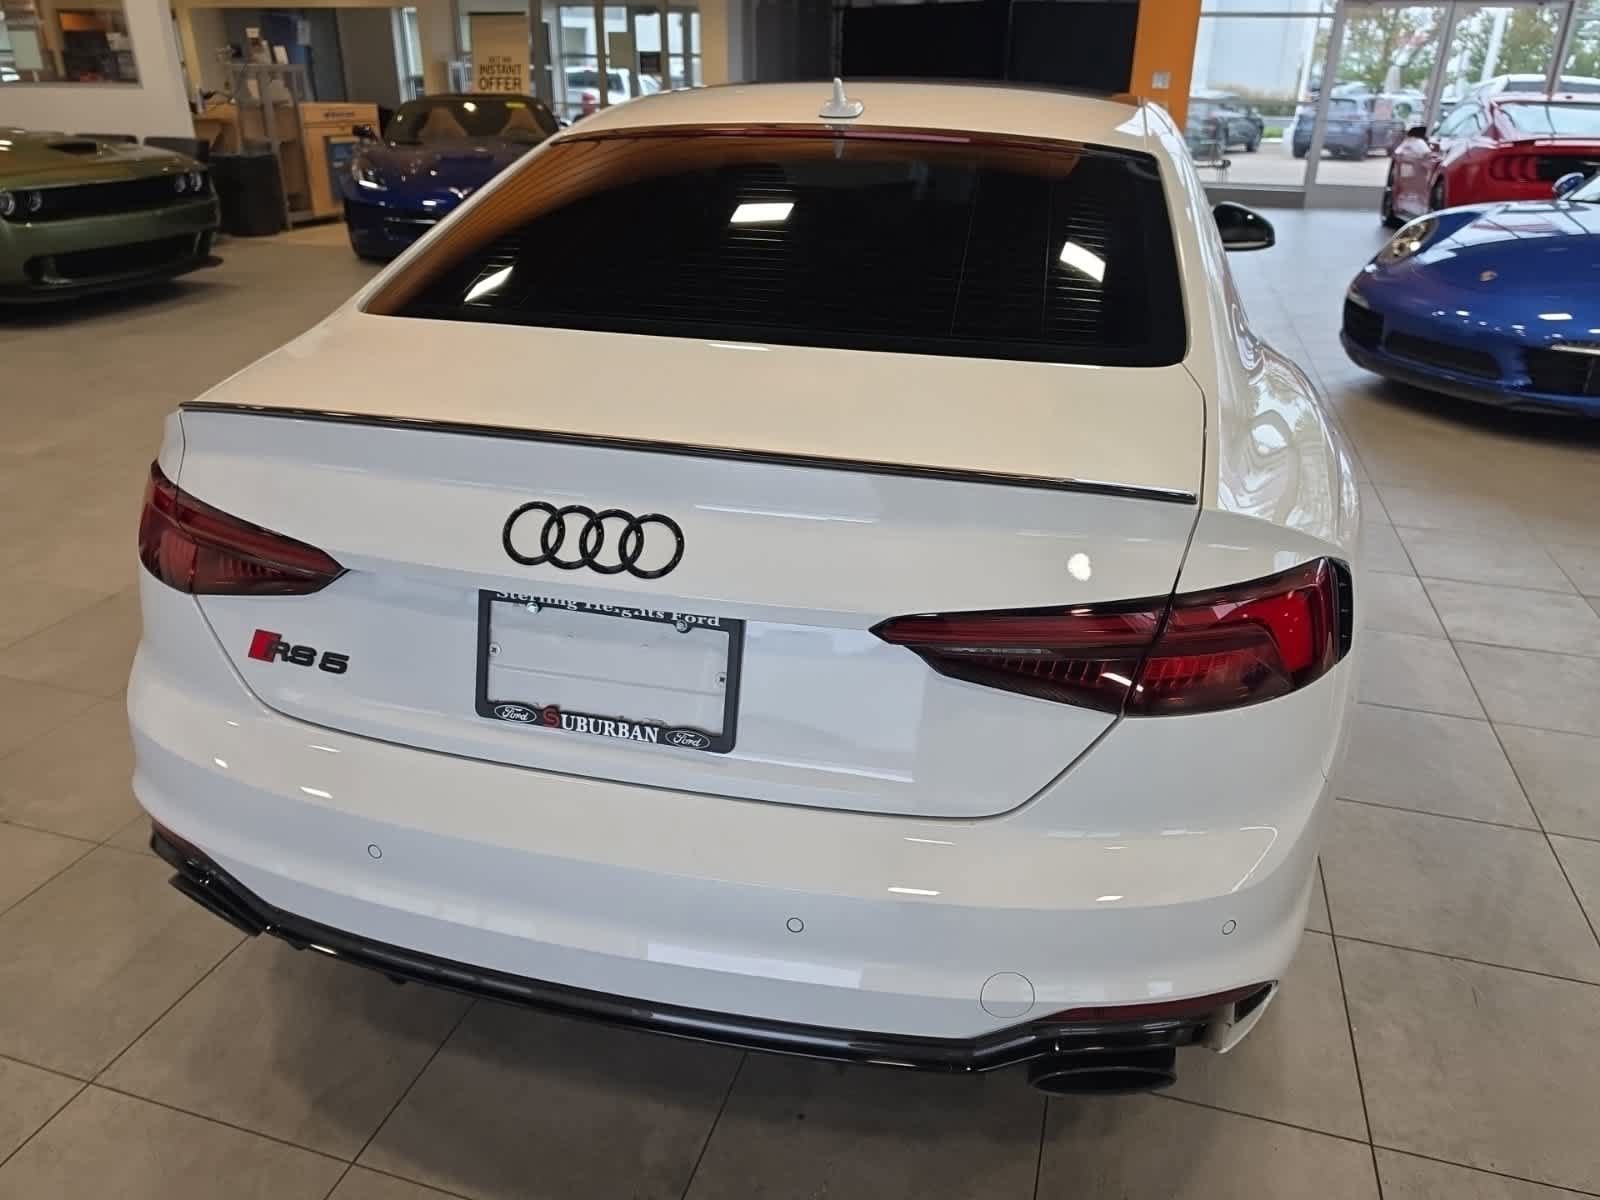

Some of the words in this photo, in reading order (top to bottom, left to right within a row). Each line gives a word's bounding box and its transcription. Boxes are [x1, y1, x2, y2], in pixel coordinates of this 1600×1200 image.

[479, 64, 522, 75] INSTANT
[479, 76, 522, 91] OFFER
[671, 612, 720, 627] Ford
[543, 705, 659, 743] SUBURBAN
